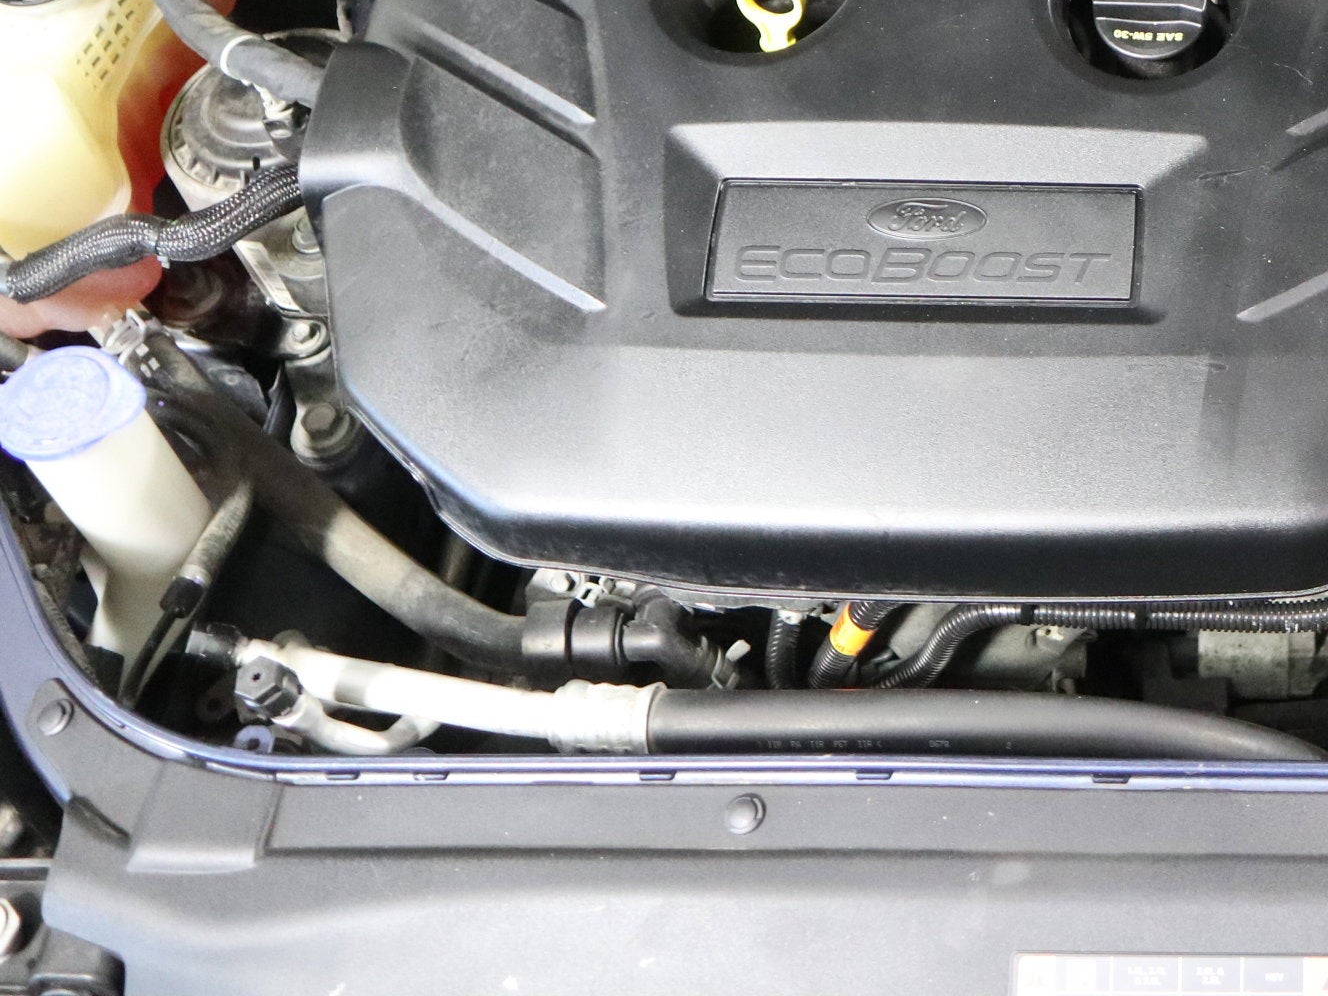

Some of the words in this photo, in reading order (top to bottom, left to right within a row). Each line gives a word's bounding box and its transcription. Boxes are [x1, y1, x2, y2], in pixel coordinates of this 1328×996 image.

[1113, 29, 1153, 41] 5W-30
[1156, 32, 1183, 41] SAE
[887, 201, 968, 232] Ford
[734, 244, 1112, 283] ECOBOOST
